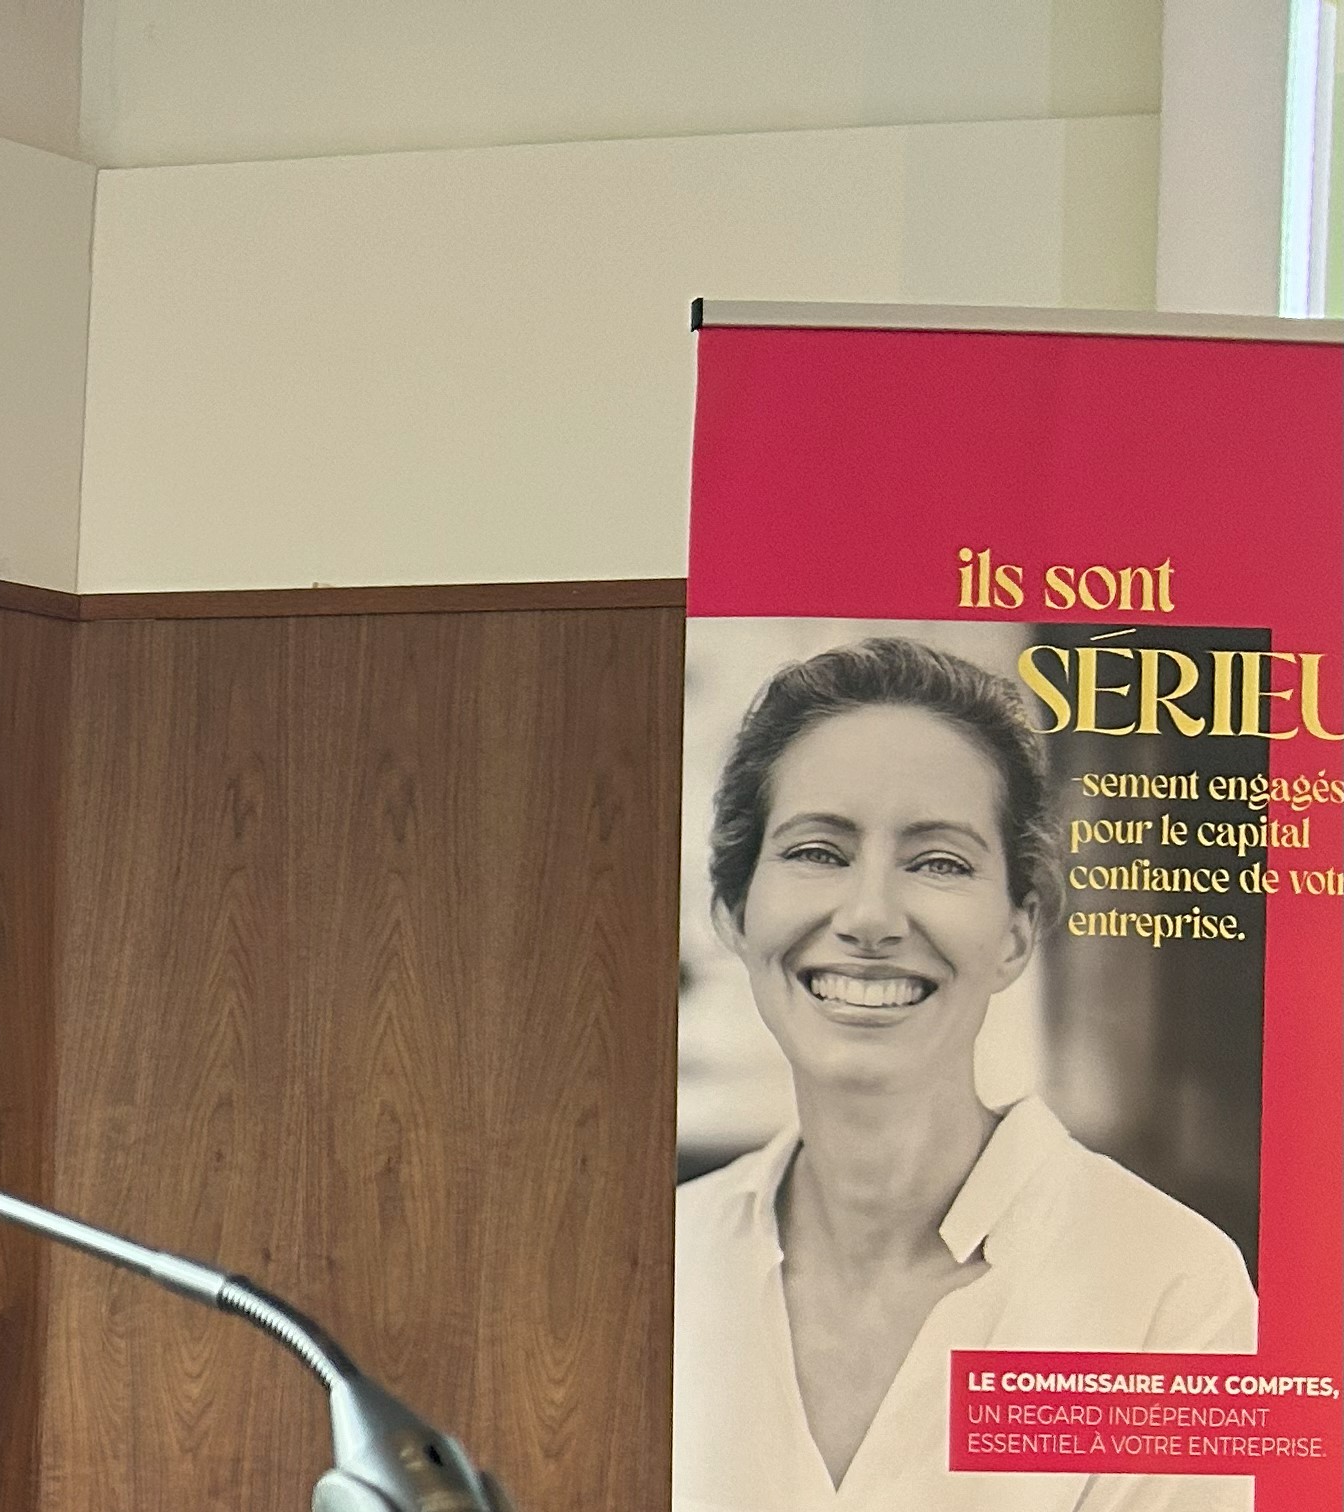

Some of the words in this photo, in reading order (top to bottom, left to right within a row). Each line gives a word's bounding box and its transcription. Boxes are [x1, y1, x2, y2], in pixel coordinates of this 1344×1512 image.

[958, 547, 1024, 608] ils
[1045, 557, 1175, 613] sont
[1209, 769, 1344, 812] engagés
[1070, 820, 1153, 853] pour
[1161, 814, 1188, 847] le
[1197, 816, 1311, 857] capital
[1068, 860, 1230, 893] confiance
[1239, 862, 1280, 895] de
[1067, 906, 1246, 948] entreprise.
[968, 1371, 996, 1392] LE
[1001, 1372, 1165, 1395] COMMISSAIRE
[1169, 1375, 1219, 1395] AUX
[1224, 1375, 1340, 1400] COMPTES,
[968, 1404, 1000, 1424] UN
[1008, 1404, 1103, 1425] REGARD
[1109, 1403, 1270, 1428] INDÉPENDANT
[968, 1432, 1086, 1454] ESSENTIEL
[1089, 1431, 1106, 1454] À
[1110, 1435, 1182, 1456] VOTRE
[1189, 1436, 1327, 1458] ENTREPRISE.
